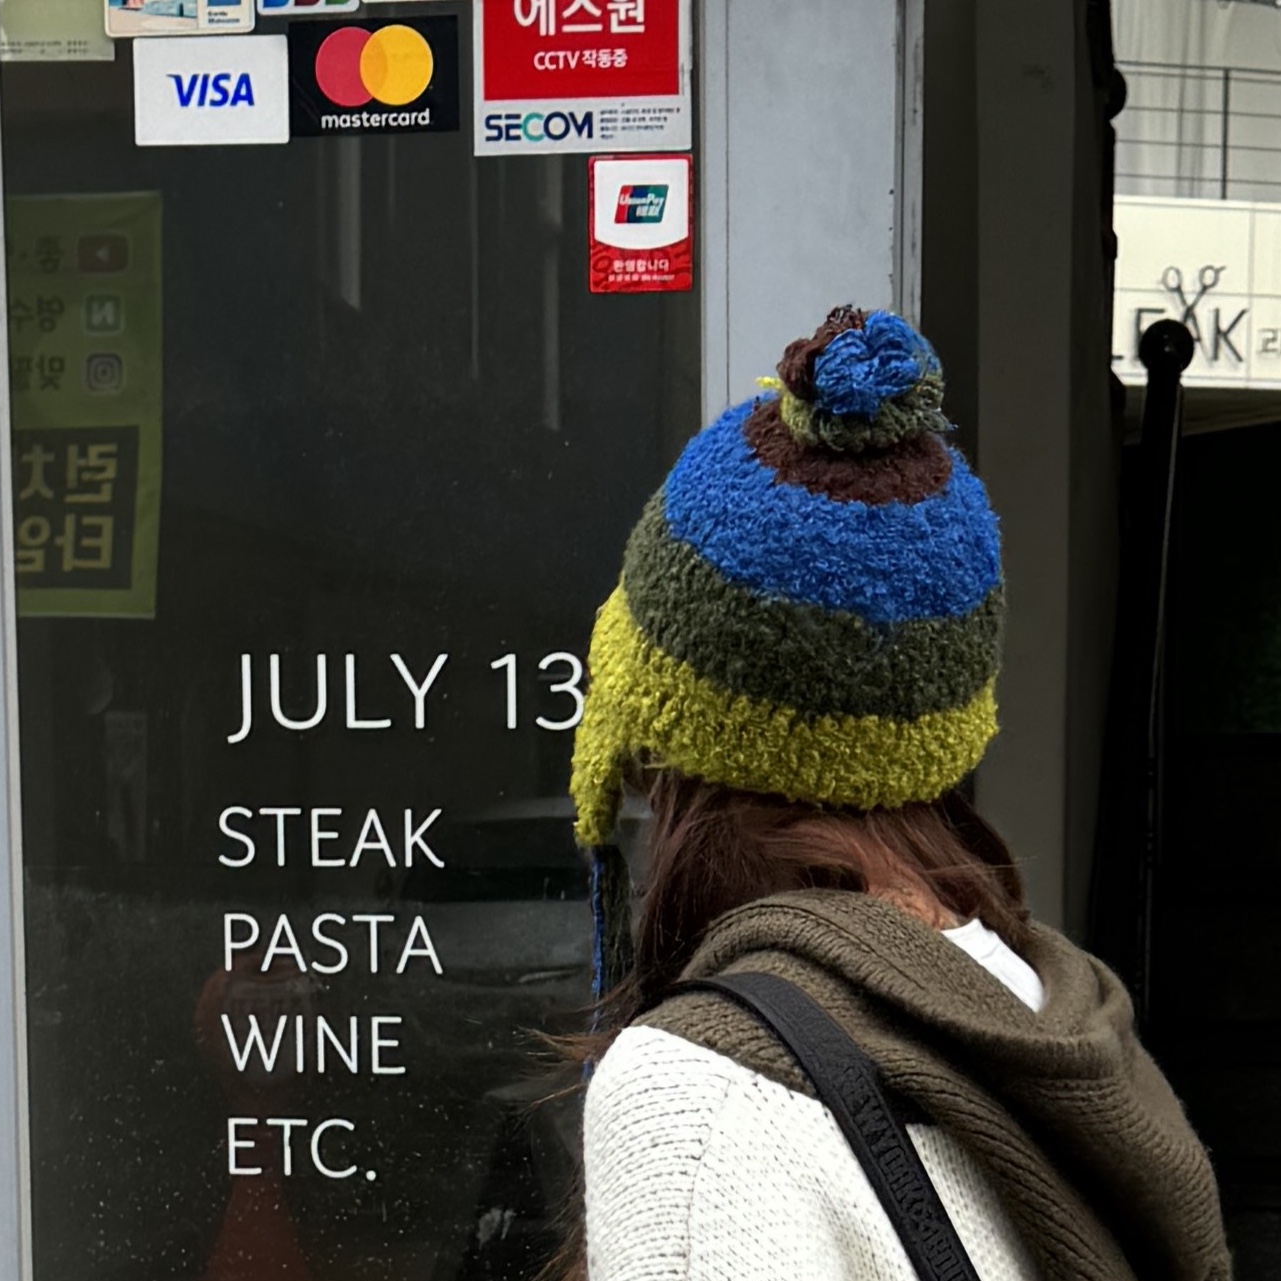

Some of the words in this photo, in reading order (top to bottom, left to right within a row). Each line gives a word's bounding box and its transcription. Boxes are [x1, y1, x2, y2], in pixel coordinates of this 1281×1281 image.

[533, 50, 580, 70] CCTV
[582, 49, 628, 68] 작동중
[168, 73, 254, 108] VISA
[321, 107, 431, 130] mastercard
[485, 111, 593, 142] SECOM
[227, 652, 448, 744] JULY
[491, 651, 585, 731] 13
[218, 806, 445, 868] STEAK
[223, 912, 444, 976] PASTA
[220, 1014, 406, 1075] WINE
[227, 1117, 377, 1182] ETC.
